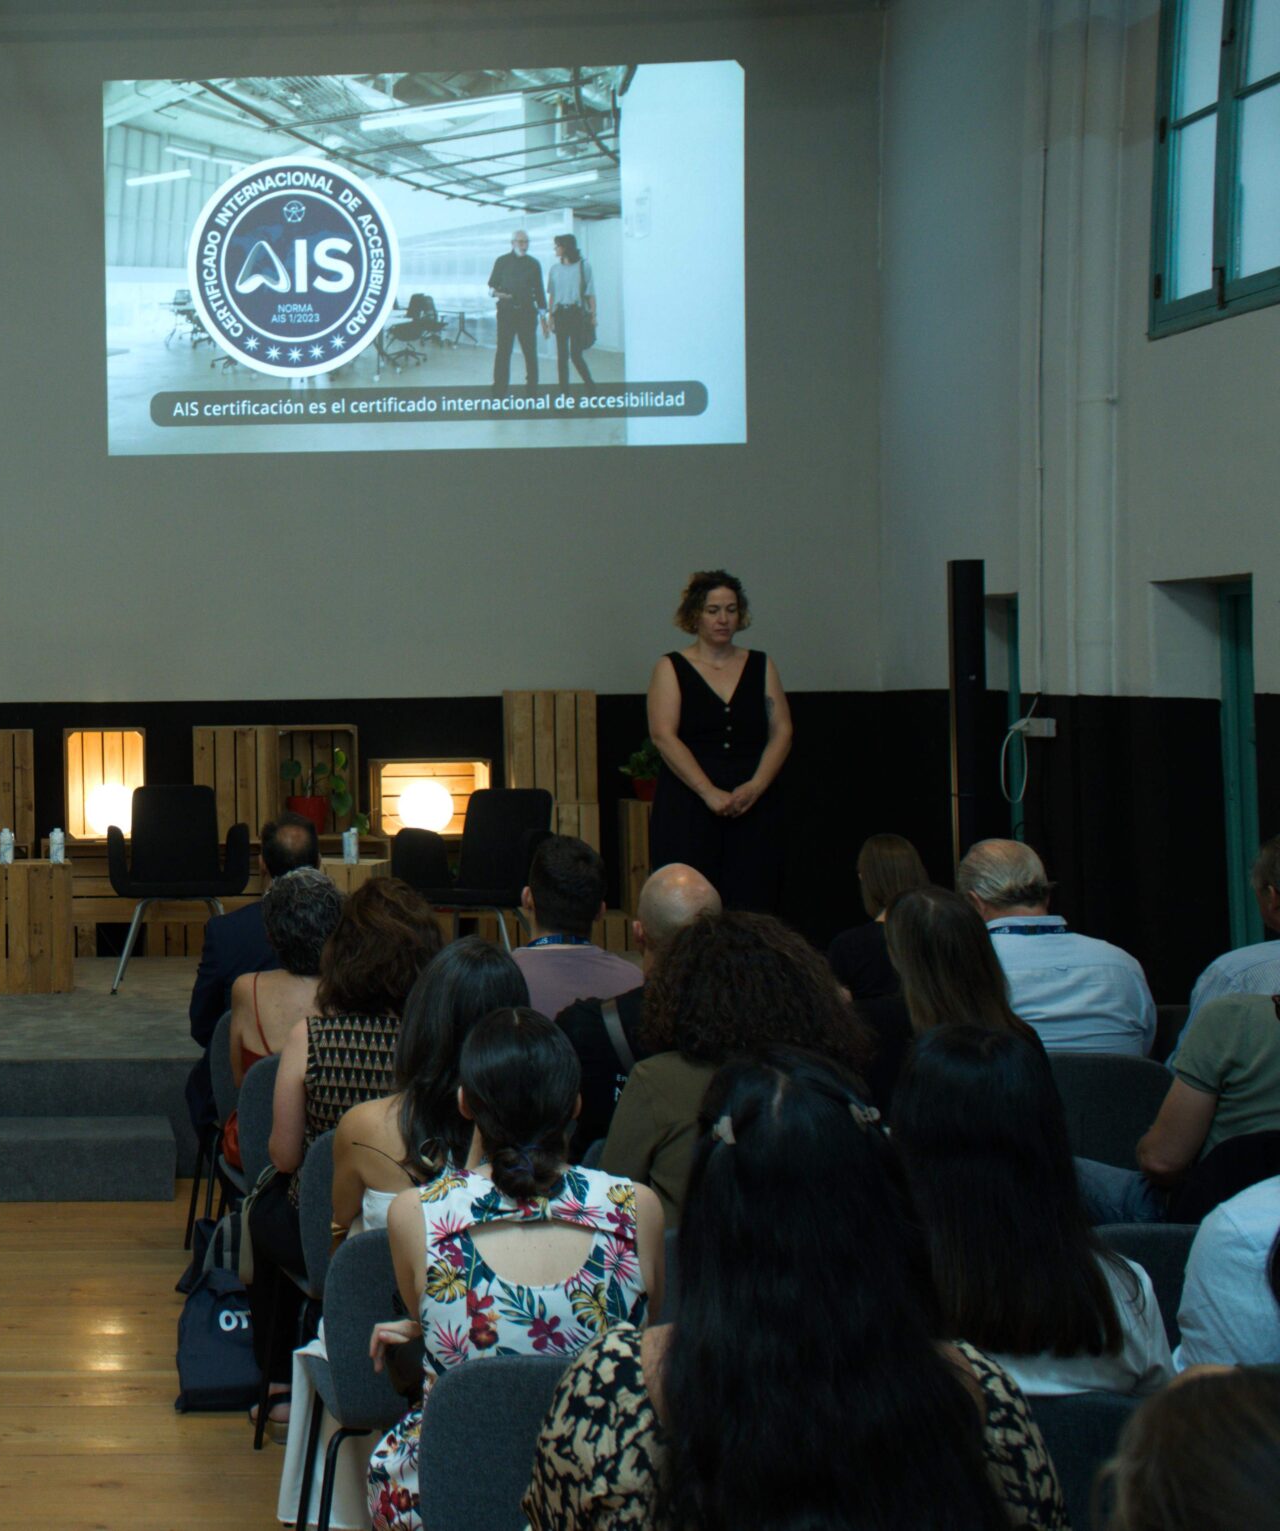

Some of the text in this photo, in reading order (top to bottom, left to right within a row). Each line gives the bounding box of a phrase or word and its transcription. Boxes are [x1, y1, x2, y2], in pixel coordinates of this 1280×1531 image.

[202, 171, 385, 338] CERTIFICADO INTERNACIONAL DE ACCESIBILIDAD
[235, 238, 355, 294] AIS
[271, 313, 320, 323] AIS 1/2023
[278, 304, 313, 313] NORMA
[173, 391, 685, 417] AIS certificación es el certificado internacional de accesibilidad
